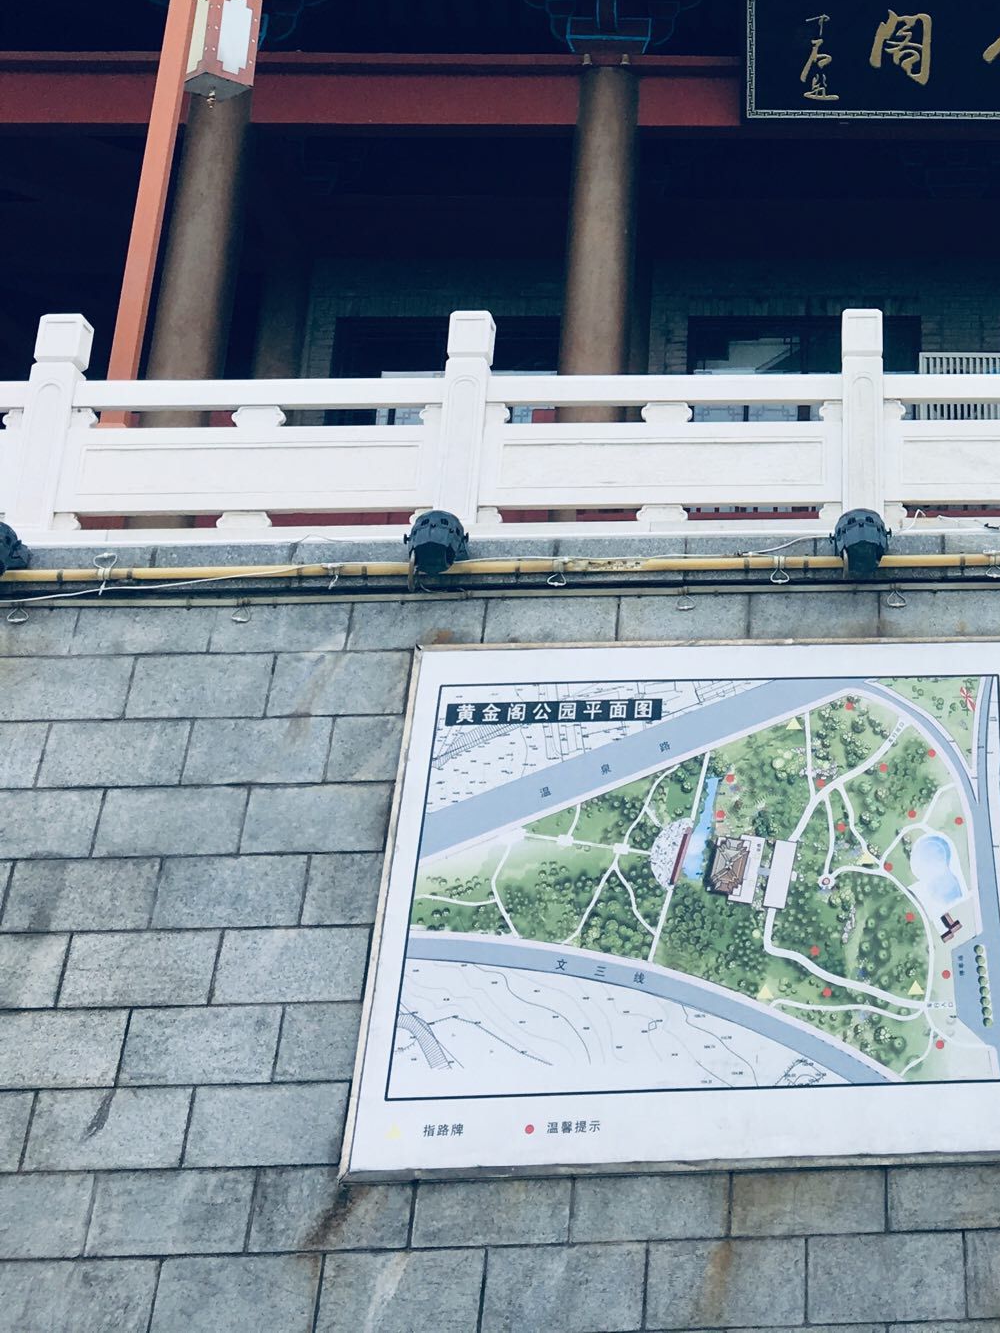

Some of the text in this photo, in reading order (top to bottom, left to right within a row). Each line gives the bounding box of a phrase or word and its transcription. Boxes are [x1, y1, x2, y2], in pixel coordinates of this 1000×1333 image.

[455, 699, 654, 724] 黄金阁公园平面图
[555, 958, 646, 984] 文三线
[423, 1123, 464, 1137] 指路牌
[546, 1120, 601, 1134] 温馨提示
